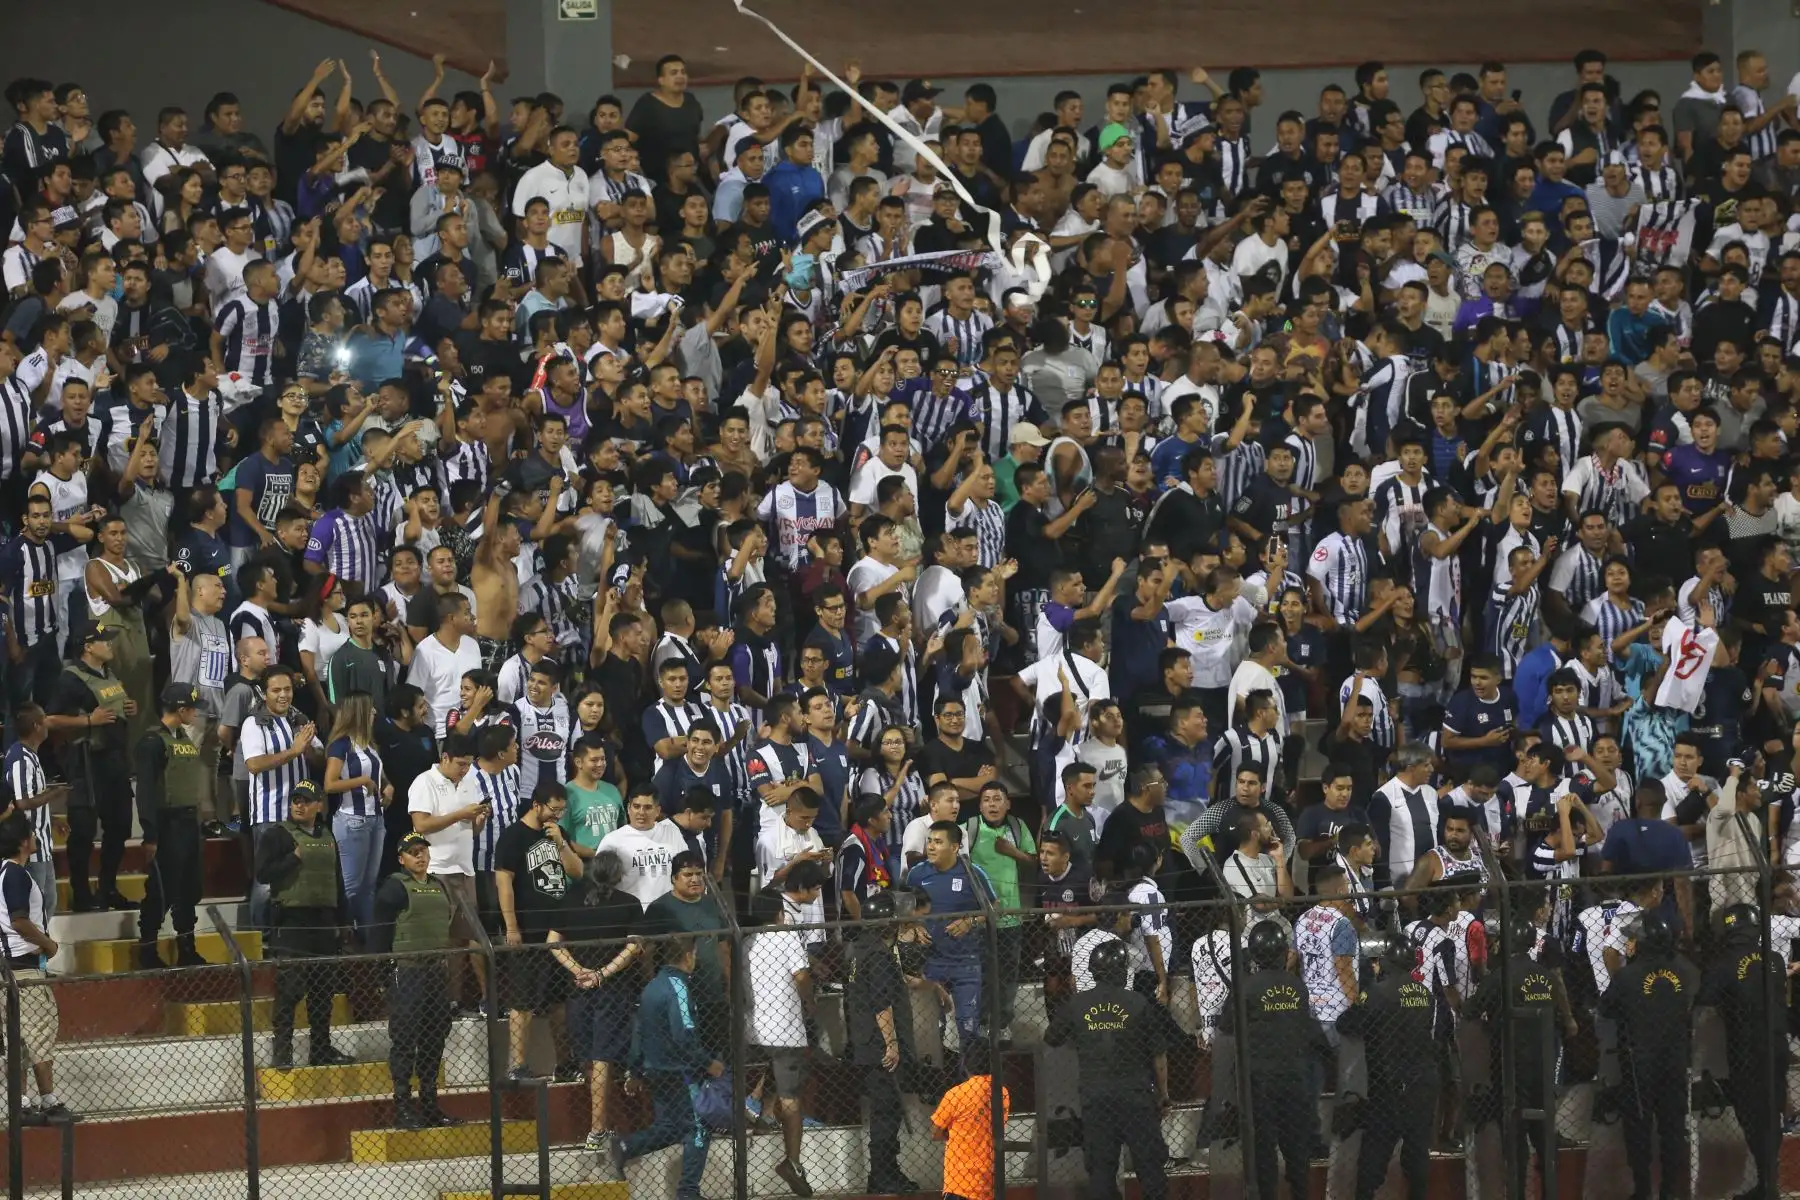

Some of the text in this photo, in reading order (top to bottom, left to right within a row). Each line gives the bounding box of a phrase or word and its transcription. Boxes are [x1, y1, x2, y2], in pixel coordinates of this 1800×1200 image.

[566, 0, 593, 9] SALIDA
[523, 735, 568, 751] Pilsen
[1105, 759, 1123, 770] NIKE
[632, 853, 673, 868] ALIANZA
[1398, 983, 1428, 997] POLICIA
[1521, 974, 1553, 993] POLICIA
[1260, 984, 1301, 1003] POLICIA
[1084, 1003, 1130, 1022] POLICIA
